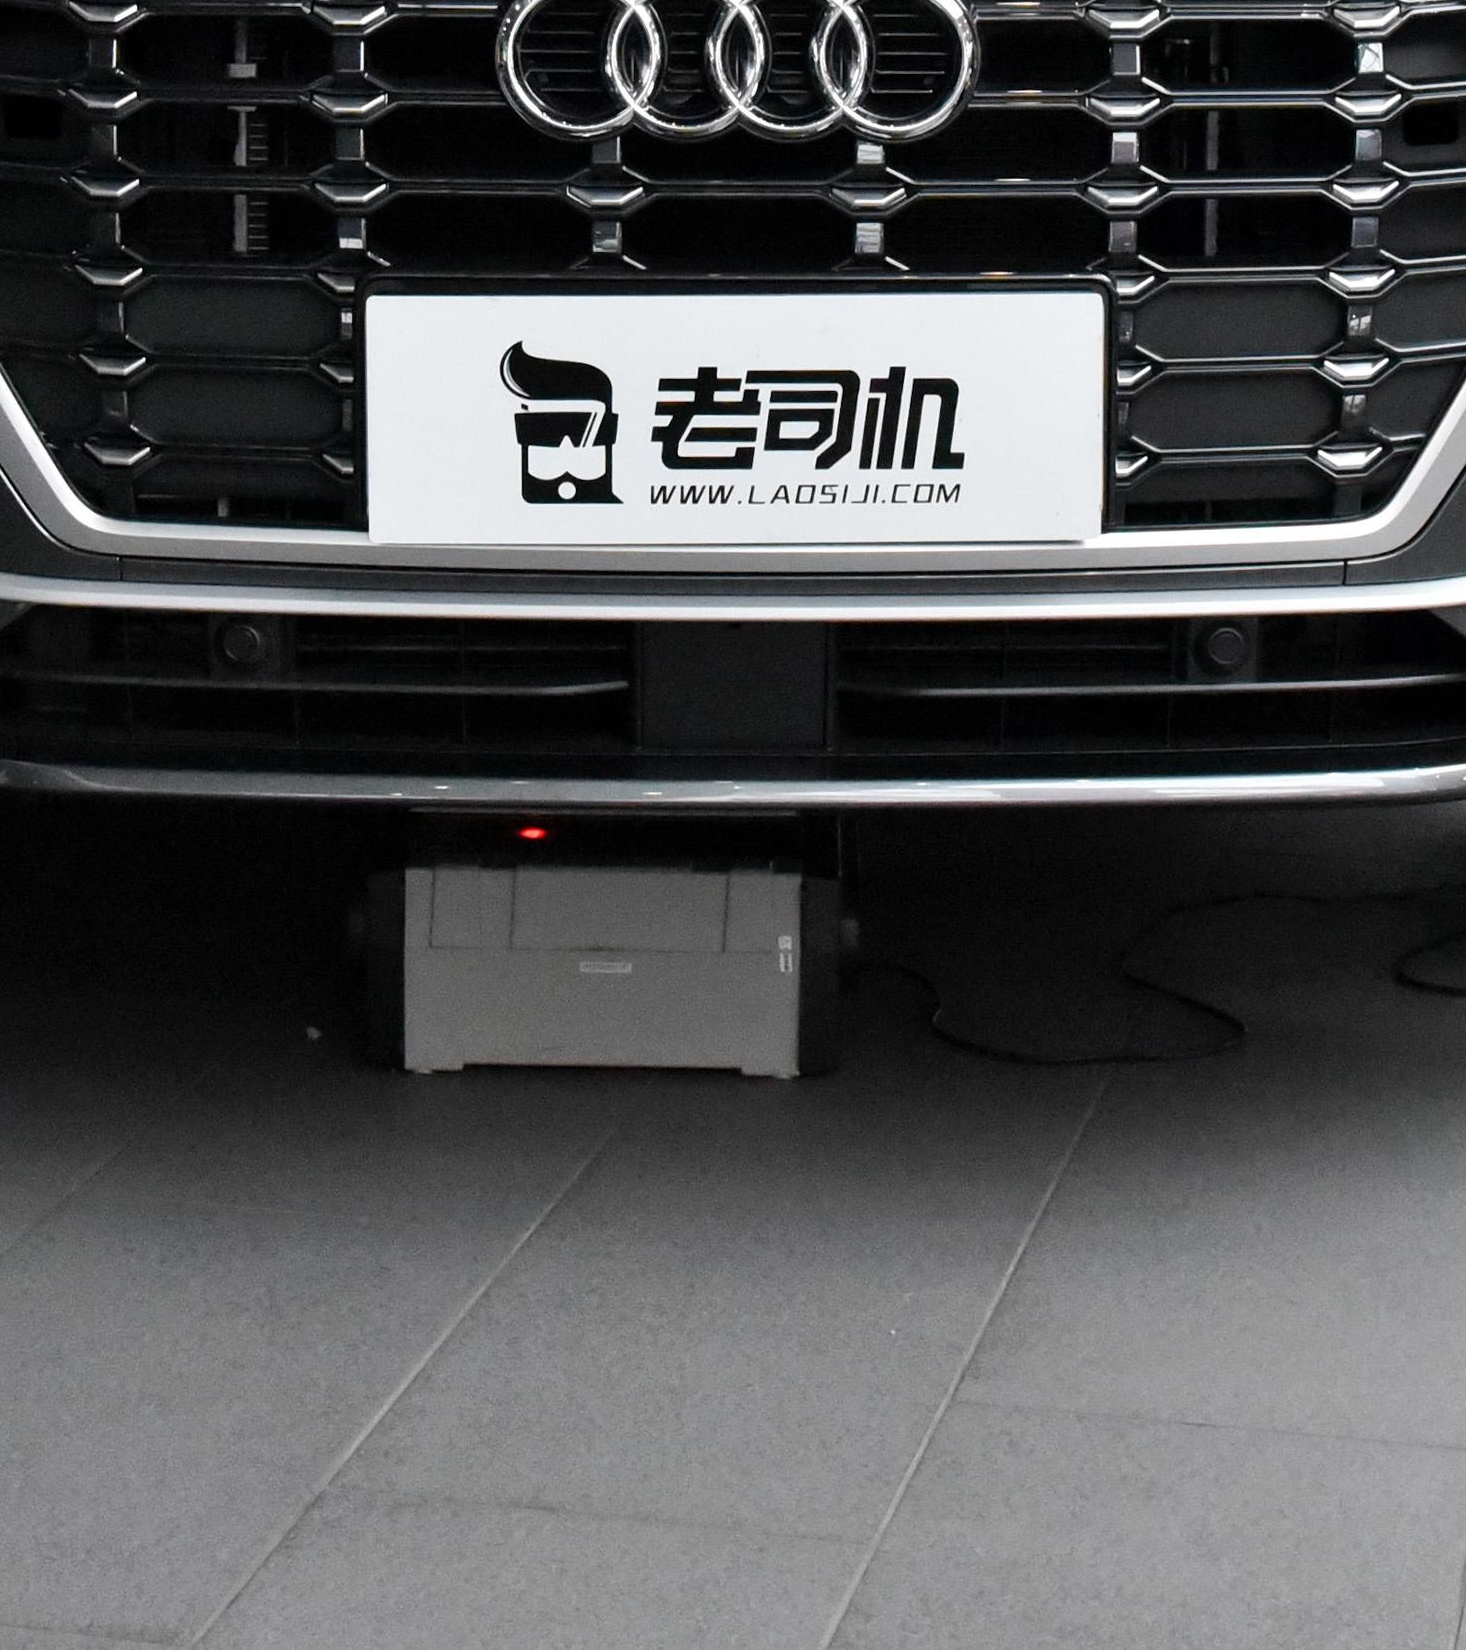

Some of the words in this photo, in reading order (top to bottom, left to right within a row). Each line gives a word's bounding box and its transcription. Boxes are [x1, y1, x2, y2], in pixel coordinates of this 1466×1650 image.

[651, 366, 965, 470] 老司机
[650, 483, 961, 505] WWW.LAOSIJI.COM
